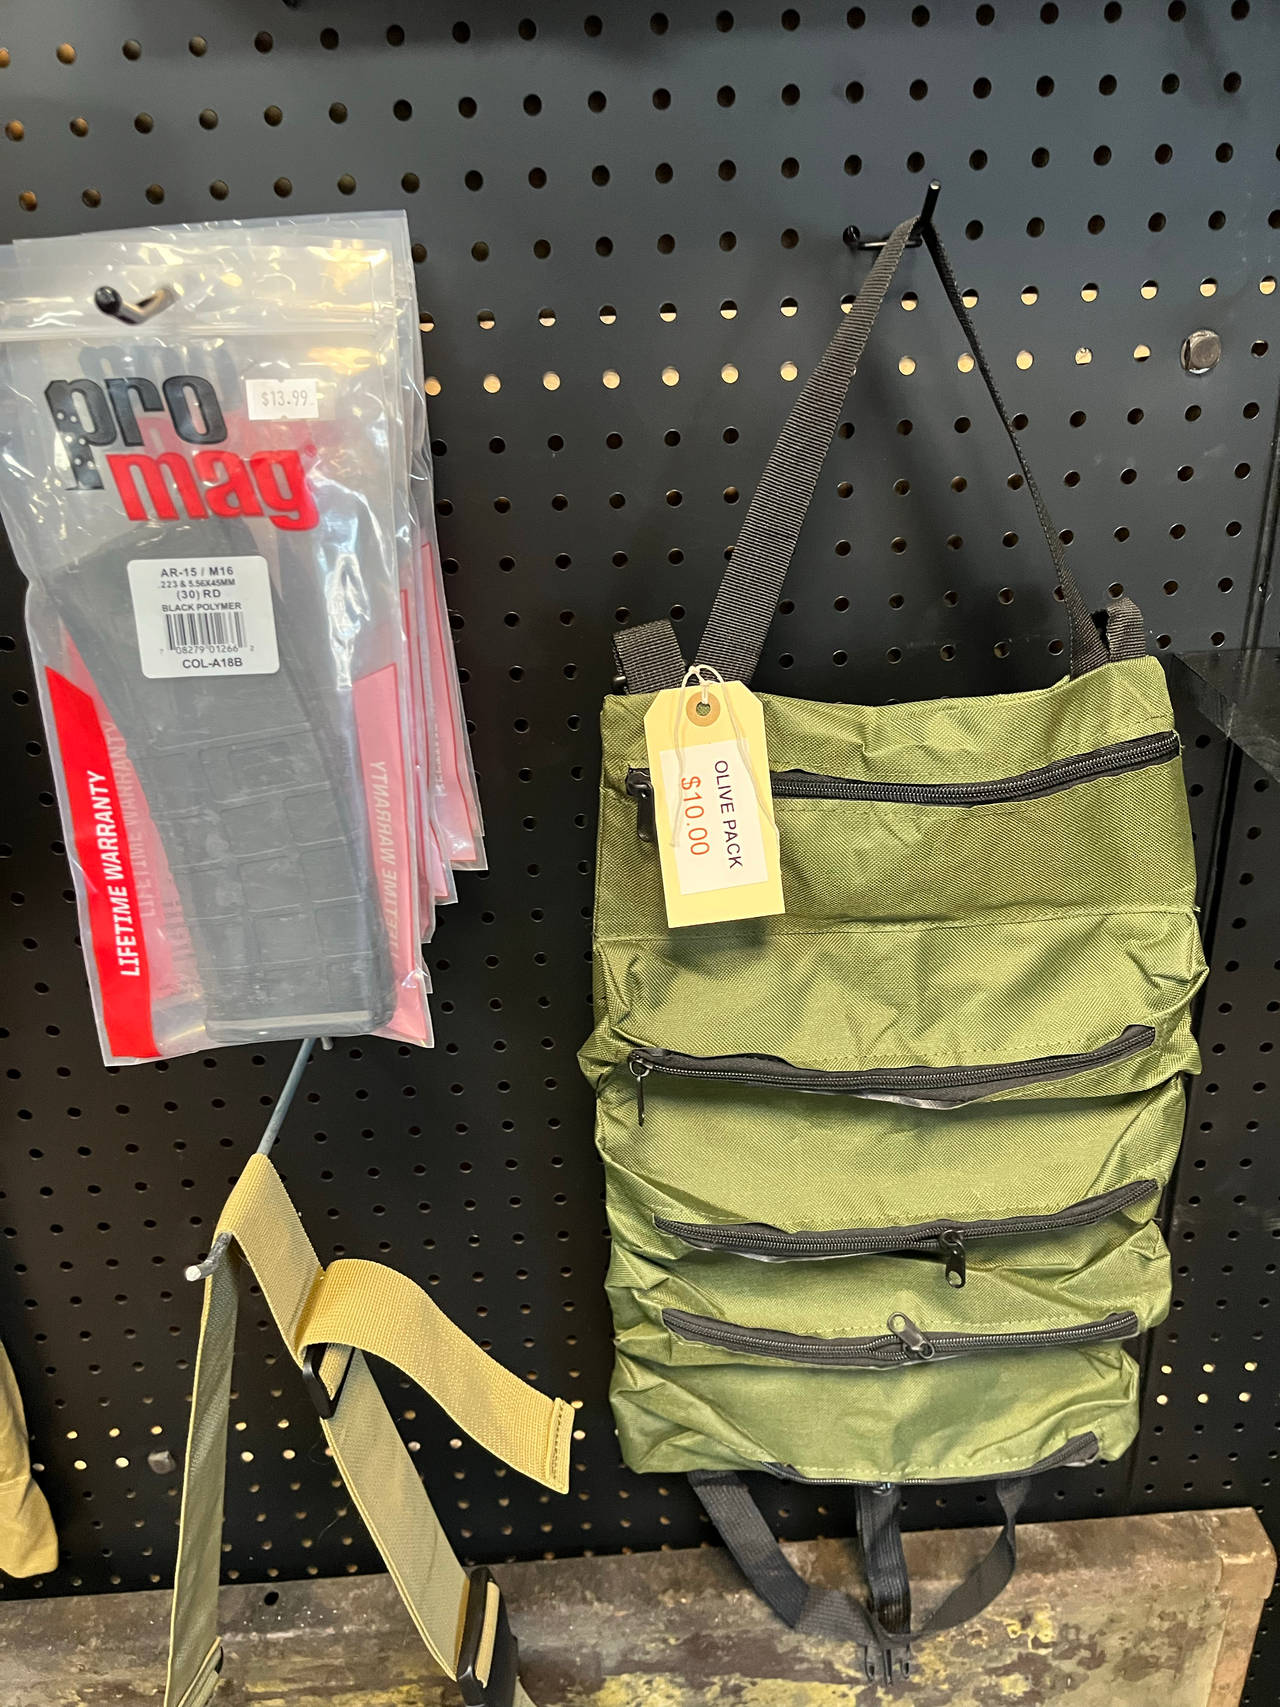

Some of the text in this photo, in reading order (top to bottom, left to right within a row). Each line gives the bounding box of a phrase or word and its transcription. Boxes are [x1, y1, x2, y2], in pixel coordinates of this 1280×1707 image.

[261, 389, 308, 407] $13.99
[44, 375, 228, 490] pro
[106, 450, 320, 531] mag
[160, 567, 198, 578] AR-15
[209, 566, 234, 576] M16
[180, 579, 187, 588] &
[188, 578, 236, 588] 5.56X45MM
[176, 589, 222, 601] (30) RD
[161, 602, 242, 613] BLACK POLYMER
[182, 657, 243, 669] COL-A18B
[681, 776, 710, 856] $10.00
[714, 760, 743, 869] OLIVE PACK
[87, 770, 140, 976] LIFETIME WARRANTY
